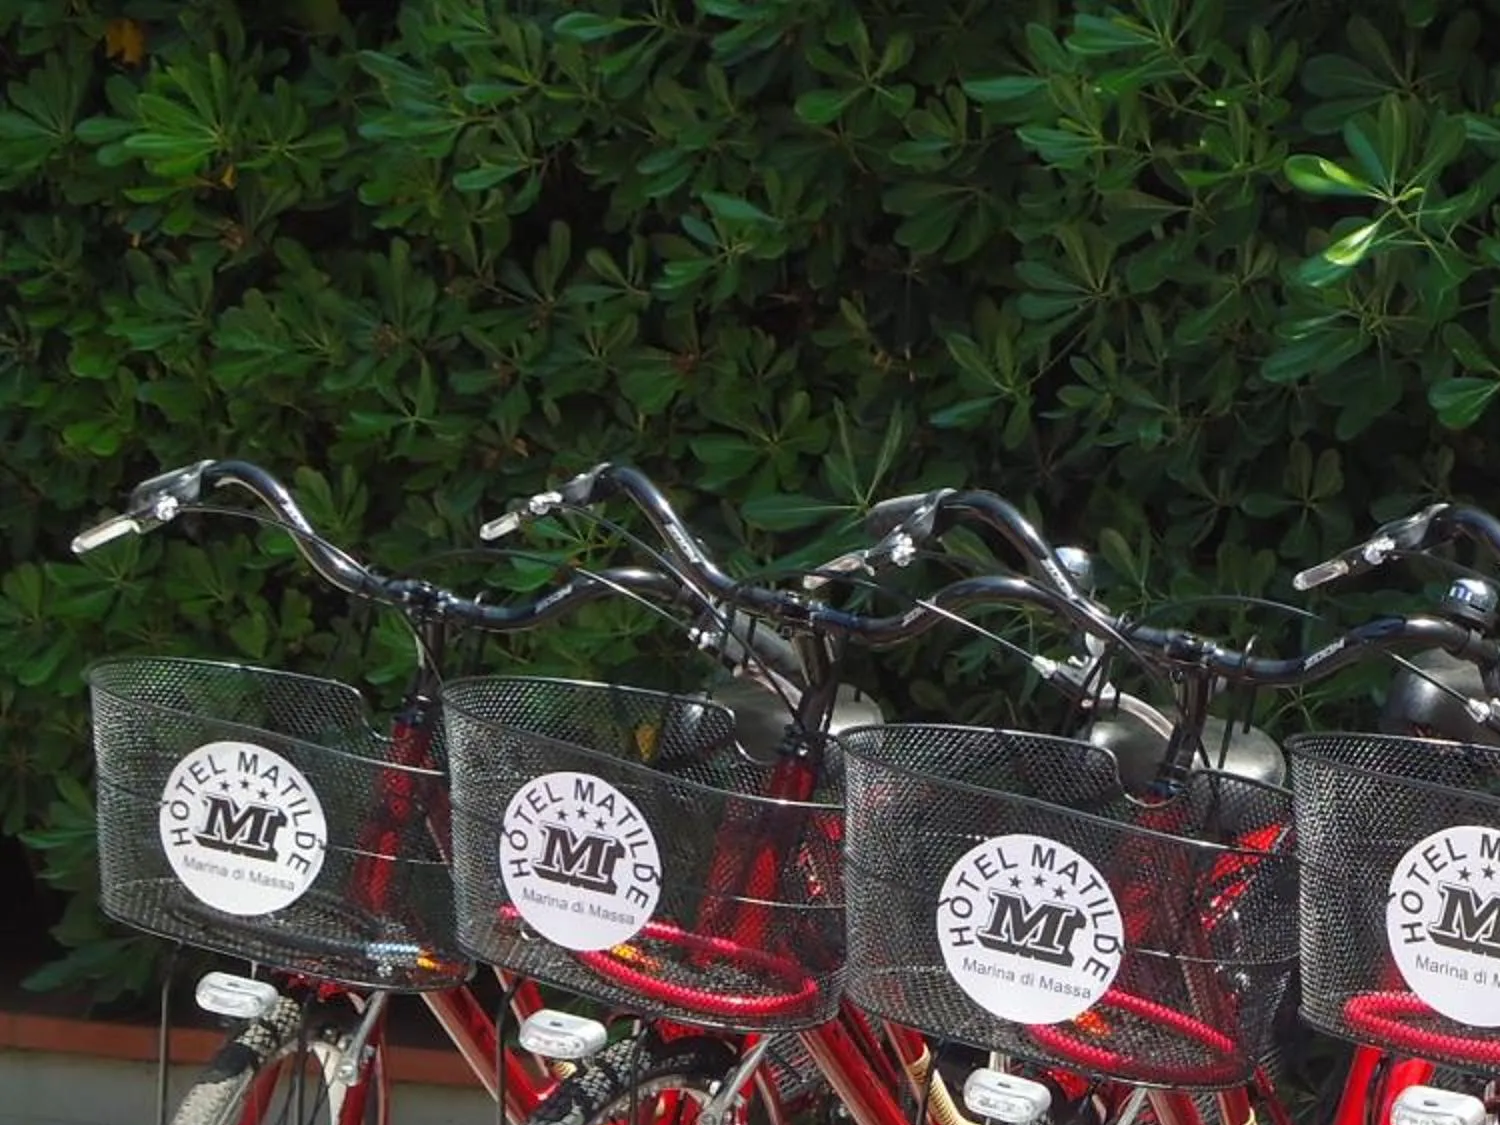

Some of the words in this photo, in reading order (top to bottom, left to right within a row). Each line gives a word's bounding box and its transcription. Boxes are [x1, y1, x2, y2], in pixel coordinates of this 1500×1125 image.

[170, 755, 226, 846] HOTEL
[237, 751, 315, 875] MATILDE
[508, 782, 563, 878] HOTEL
[574, 779, 654, 909] MATILDE
[183, 855, 228, 877] Marina
[232, 868, 246, 880] di
[249, 871, 295, 891] Massa
[522, 888, 568, 910] Marina
[572, 899, 585, 913] di
[589, 904, 635, 925] Massa
[1400, 837, 1467, 945] HOTEL
[949, 847, 1018, 946] HOTEL
[1031, 843, 1119, 981] MATILDE
[962, 957, 1016, 981] Marina
[1021, 972, 1034, 987] di
[1039, 975, 1091, 999] Massa
[1415, 954, 1468, 981] Marina
[1474, 968, 1487, 985] di
